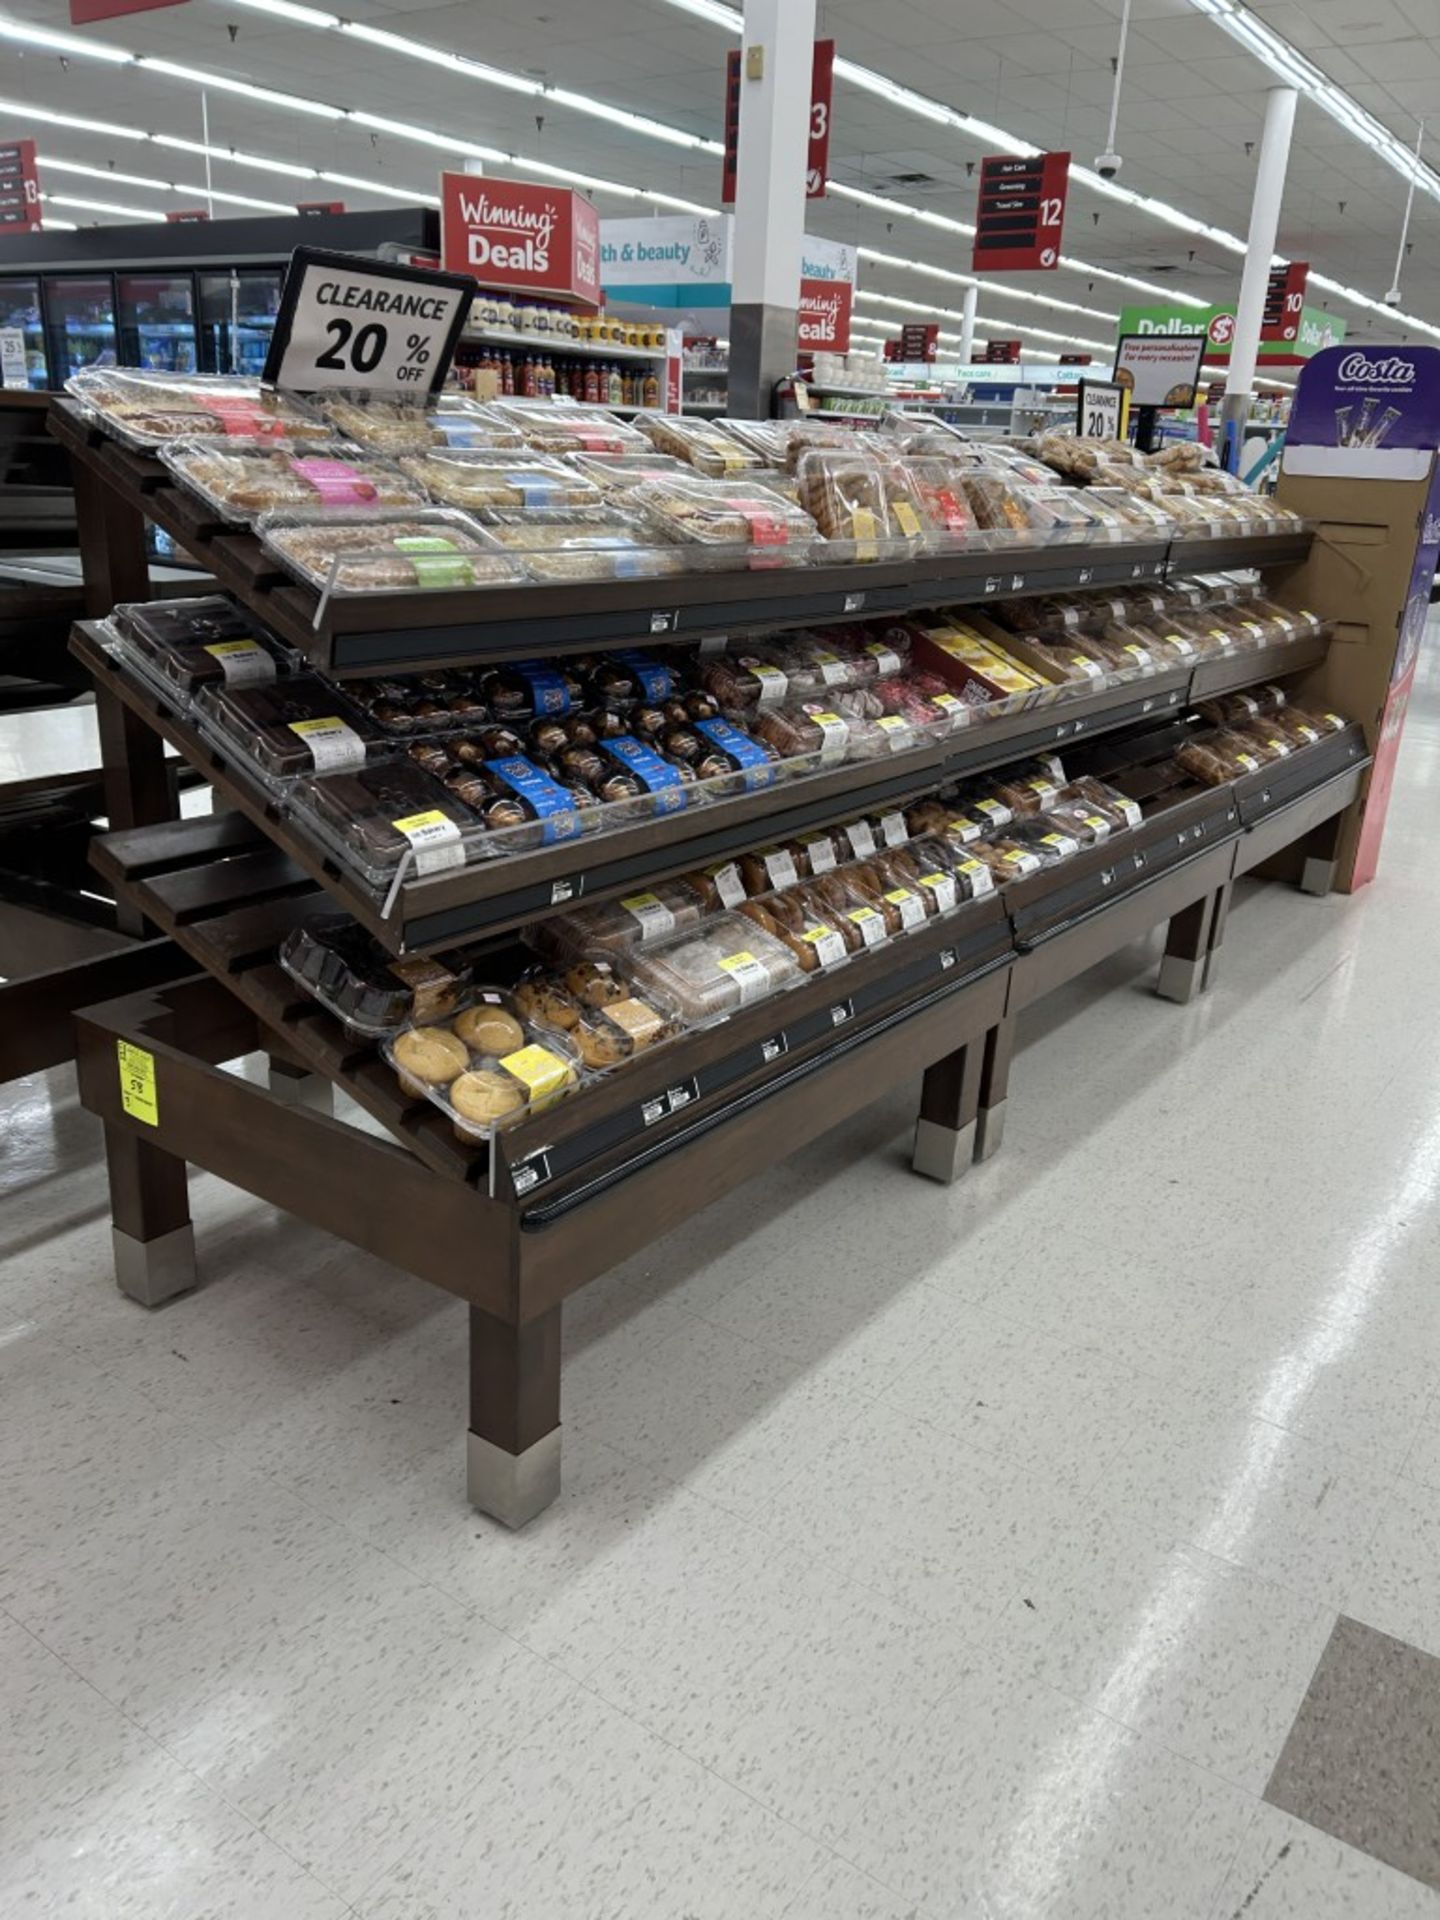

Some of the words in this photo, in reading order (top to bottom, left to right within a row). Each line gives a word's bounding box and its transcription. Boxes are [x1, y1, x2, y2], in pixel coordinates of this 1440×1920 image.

[24, 180, 36, 203] 13
[459, 193, 552, 249] Winning
[1040, 198, 1062, 226] 12
[468, 234, 549, 272] Deals
[619, 244, 633, 262] &
[637, 242, 691, 265] beauty
[316, 282, 449, 321] CLEARANCE
[1286, 293, 1303, 312] 10
[314, 318, 388, 374] 20
[406, 334, 431, 364] %
[396, 366, 425, 382] OFF
[1338, 352, 1416, 384] Costa
[1086, 392, 1117, 409] CLEARANCE
[1088, 410, 1105, 438] 20
